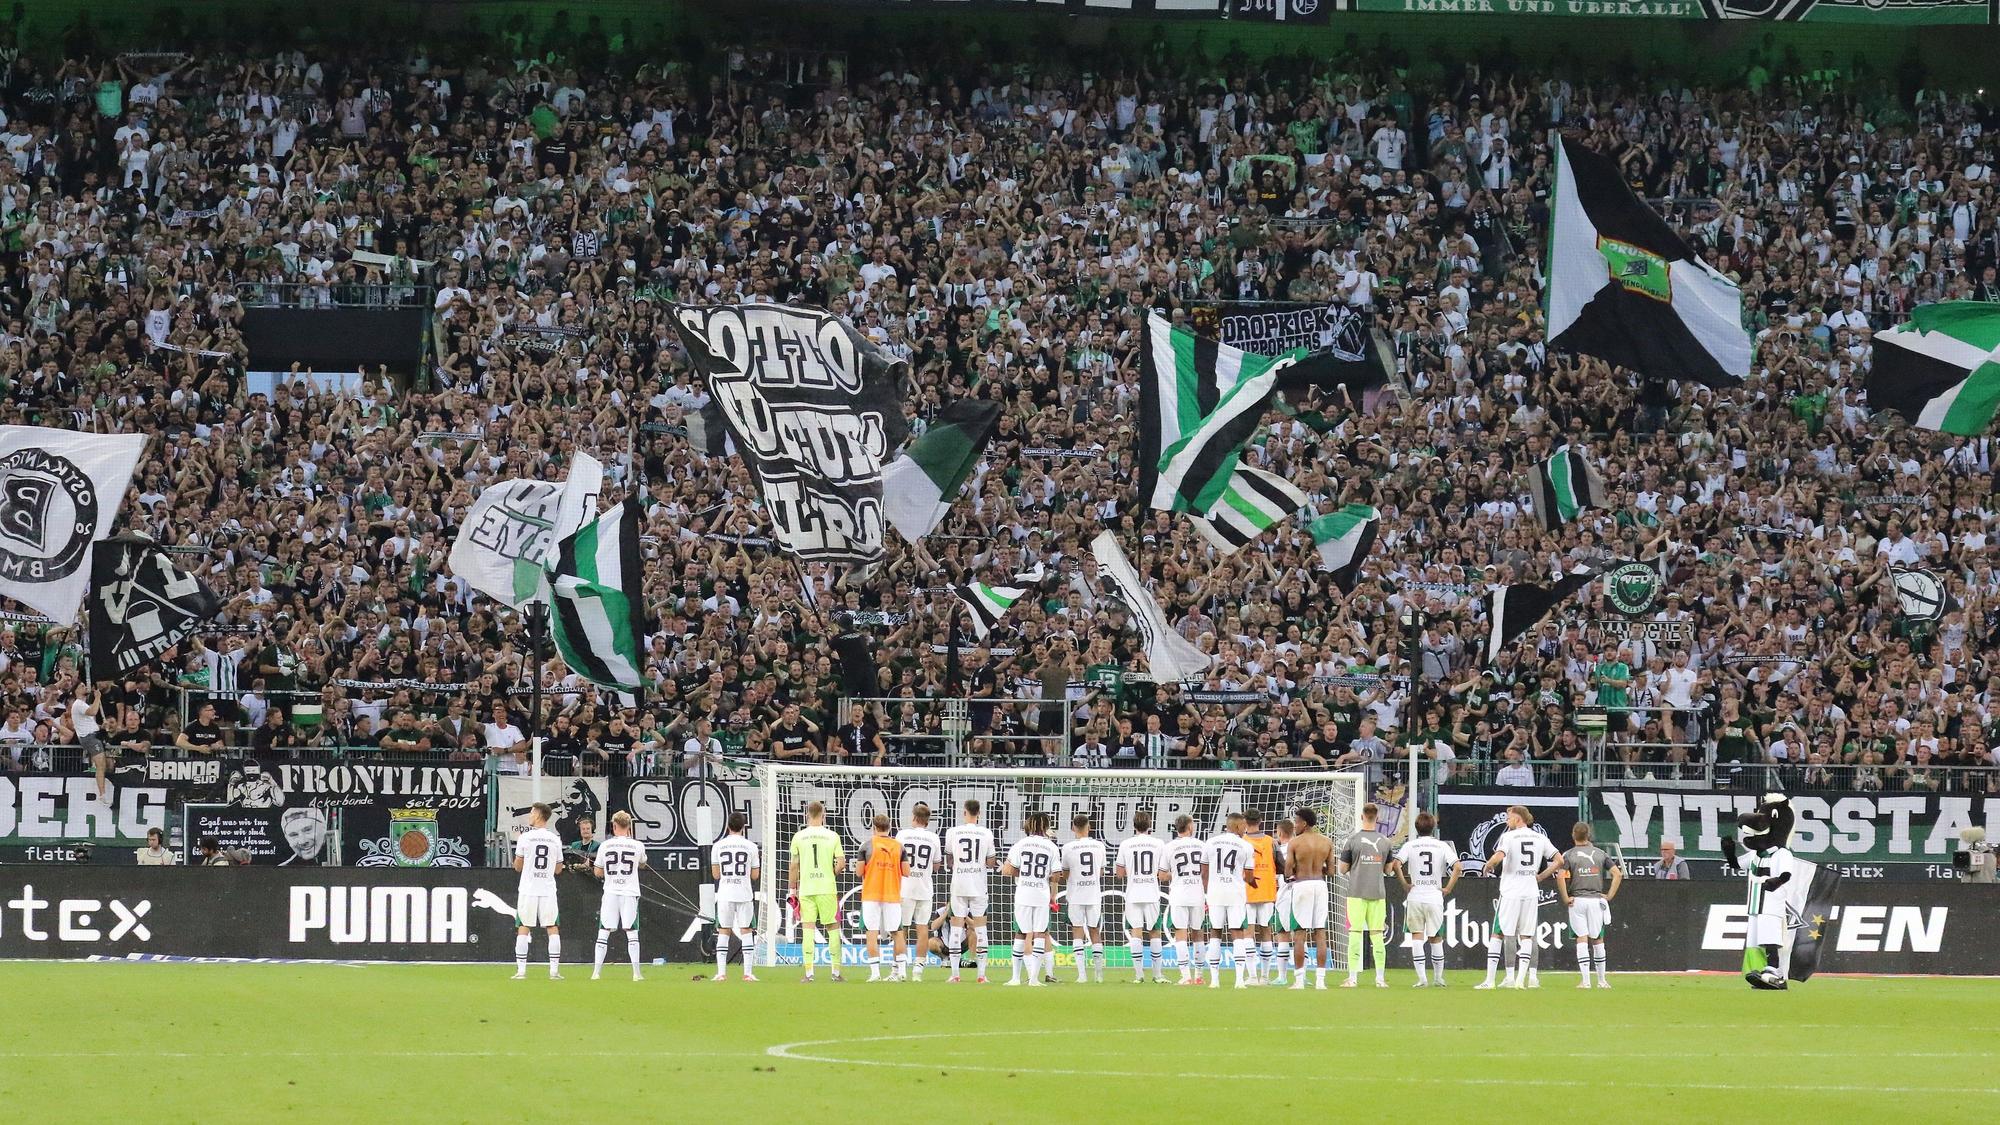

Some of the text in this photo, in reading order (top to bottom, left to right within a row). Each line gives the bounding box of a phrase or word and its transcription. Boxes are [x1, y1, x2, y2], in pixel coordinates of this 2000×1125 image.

[1404, 0, 1494, 11] IMMER
[1508, 0, 1555, 12] UND
[1222, 307, 1332, 343] DROPKICK
[676, 305, 862, 394] SOTTO
[150, 760, 220, 781] BANDA
[278, 764, 483, 797] FRONTLINE
[438, 797, 481, 809] 2006
[1602, 792, 2000, 854] VITSSTA
[534, 845, 549, 870] 8
[605, 851, 636, 875] 25
[719, 851, 749, 876] 28
[812, 843, 819, 869] 1
[903, 843, 932, 870] 39
[958, 838, 981, 863] 31
[1133, 850, 1154, 876] 10
[1216, 847, 1238, 875] 14
[1419, 851, 1433, 876] 3
[1520, 842, 1534, 866] 5
[1020, 851, 1049, 878] 38
[1080, 851, 1094, 877] 9
[0, 884, 152, 943] tex
[289, 886, 468, 943] PUMA
